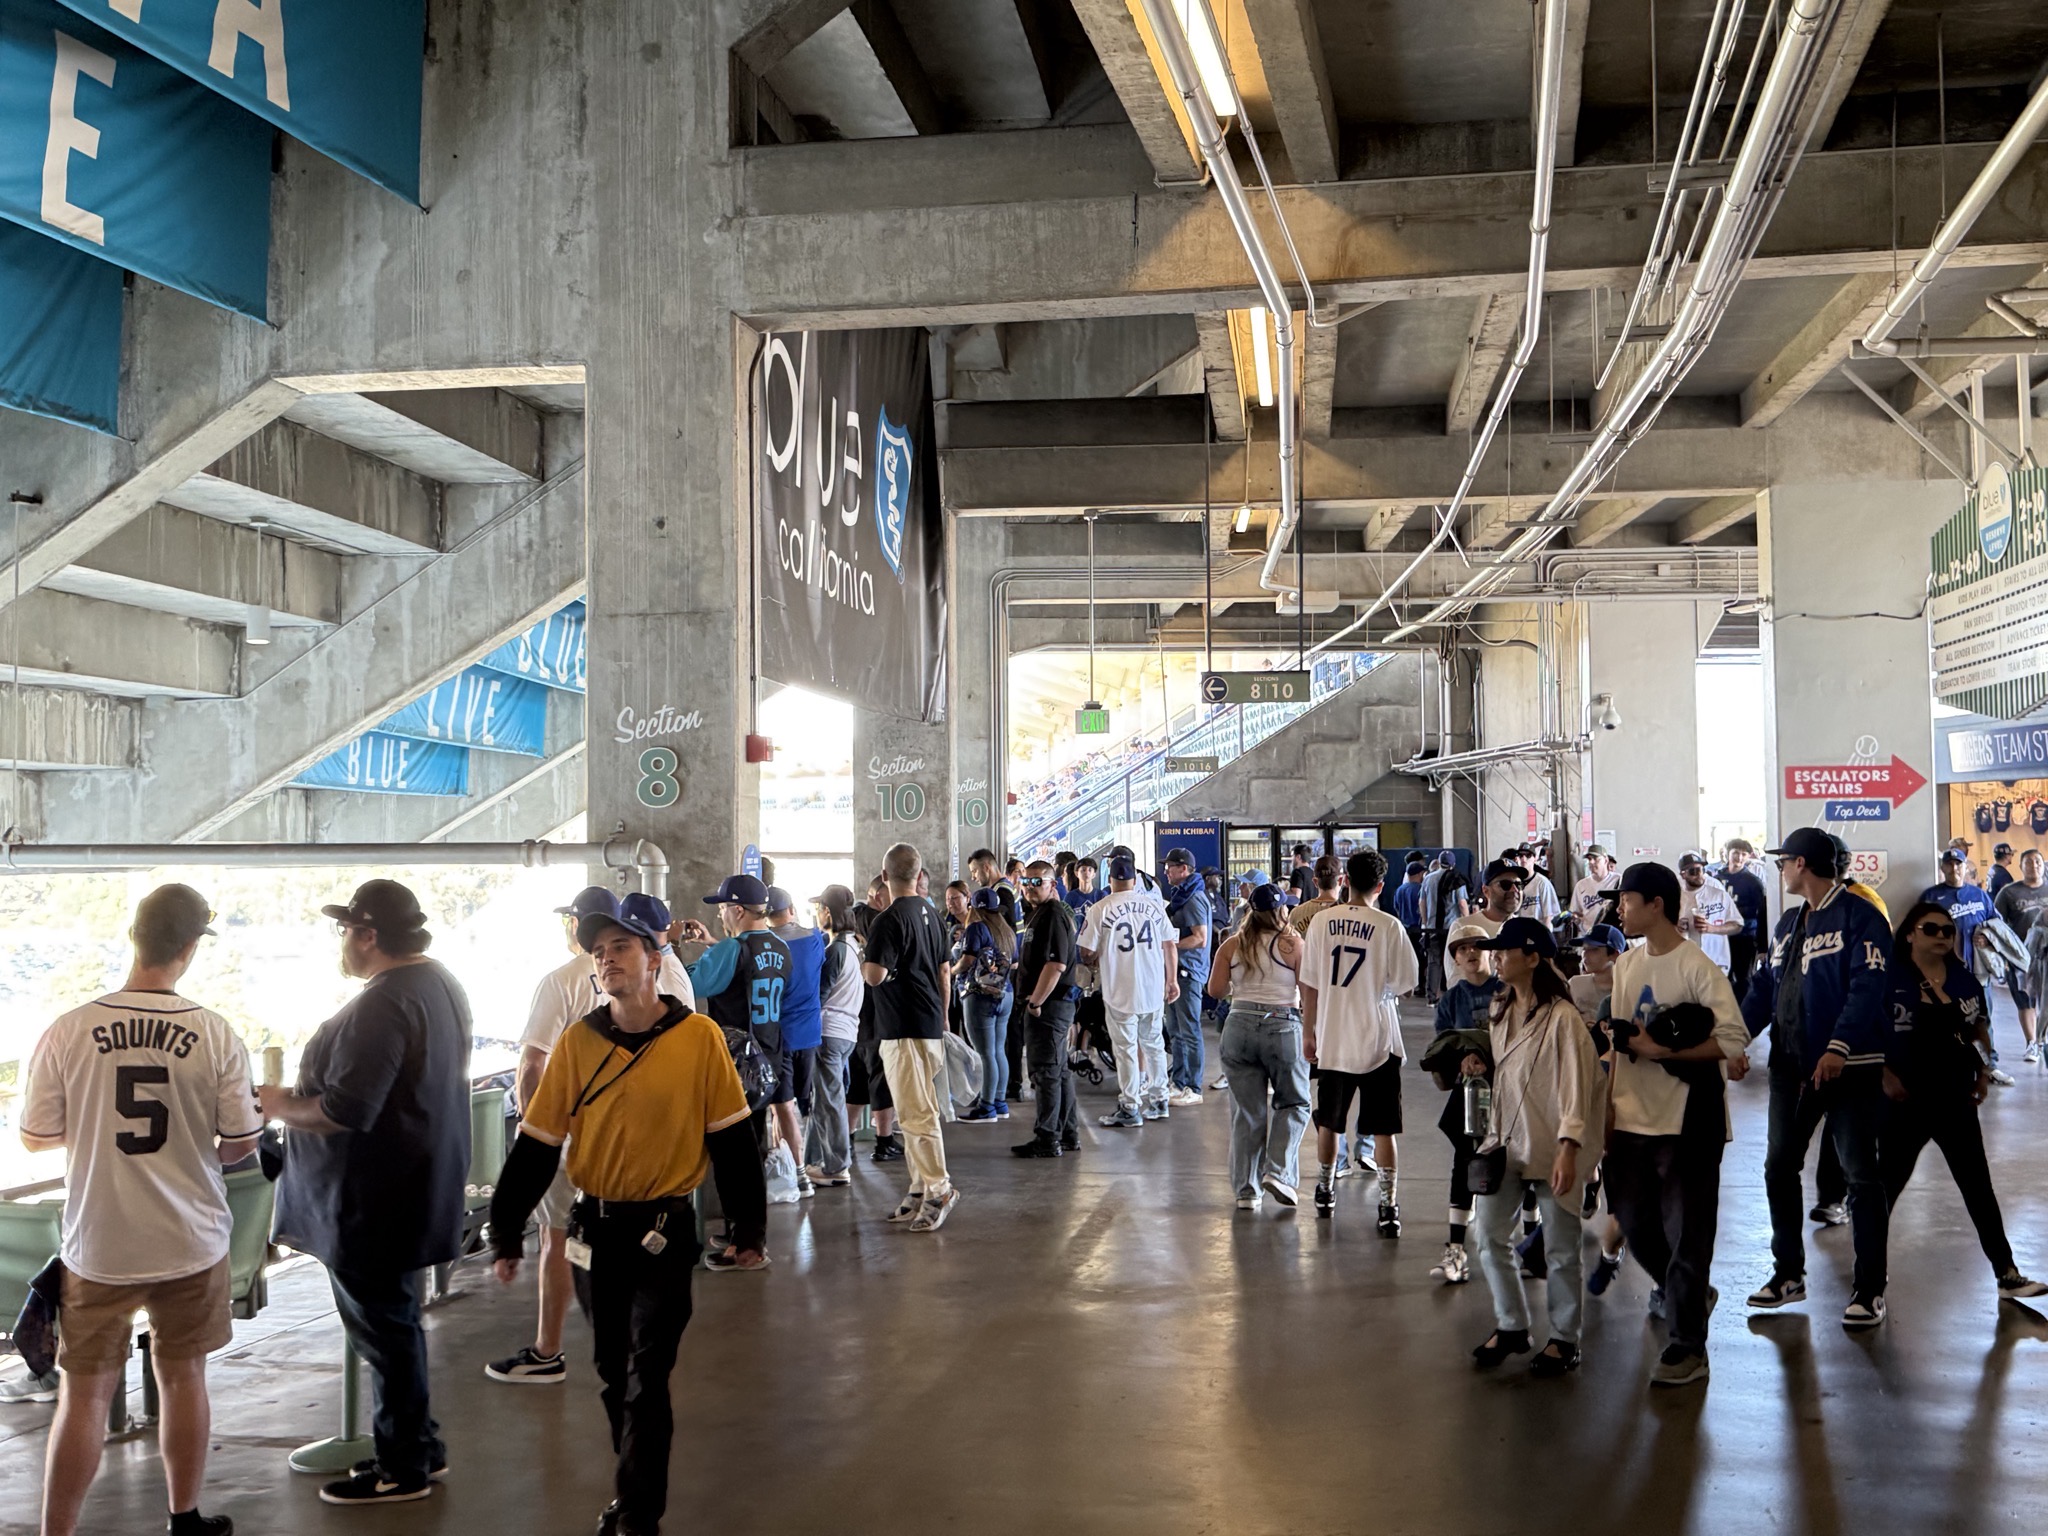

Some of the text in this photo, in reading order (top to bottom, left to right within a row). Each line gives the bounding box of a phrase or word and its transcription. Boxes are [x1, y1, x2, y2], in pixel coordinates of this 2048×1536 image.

[41, 29, 117, 246] E
[1250, 682, 1294, 699] 8 10
[426, 671, 502, 746] LIVE
[1081, 711, 1106, 733] EXIT
[614, 704, 703, 744] Section
[1994, 730, 2032, 763] TEAM
[347, 735, 411, 789] BLUE
[866, 753, 926, 781] Section
[1184, 762, 1212, 771] 10 16
[1794, 769, 1890, 782] ESCALATORS
[636, 746, 680, 809] 8
[956, 777, 988, 795] ection
[1795, 782, 1863, 795] & STAIRS
[874, 782, 926, 823] 10
[1834, 804, 1882, 819] Top Deck
[1159, 827, 1216, 836] KIRIN ICHIBAN
[1848, 854, 1879, 872] 53
[1101, 901, 1163, 929] VALENZUELA
[1115, 919, 1153, 953] 34
[1328, 919, 1376, 941] OHTANI
[754, 951, 785, 971] BETTS
[1331, 944, 1367, 988] 17
[1863, 941, 1886, 972] LA
[751, 977, 785, 1025] 50
[92, 1018, 199, 1059] SQUINTS
[115, 1065, 169, 1155] 5
